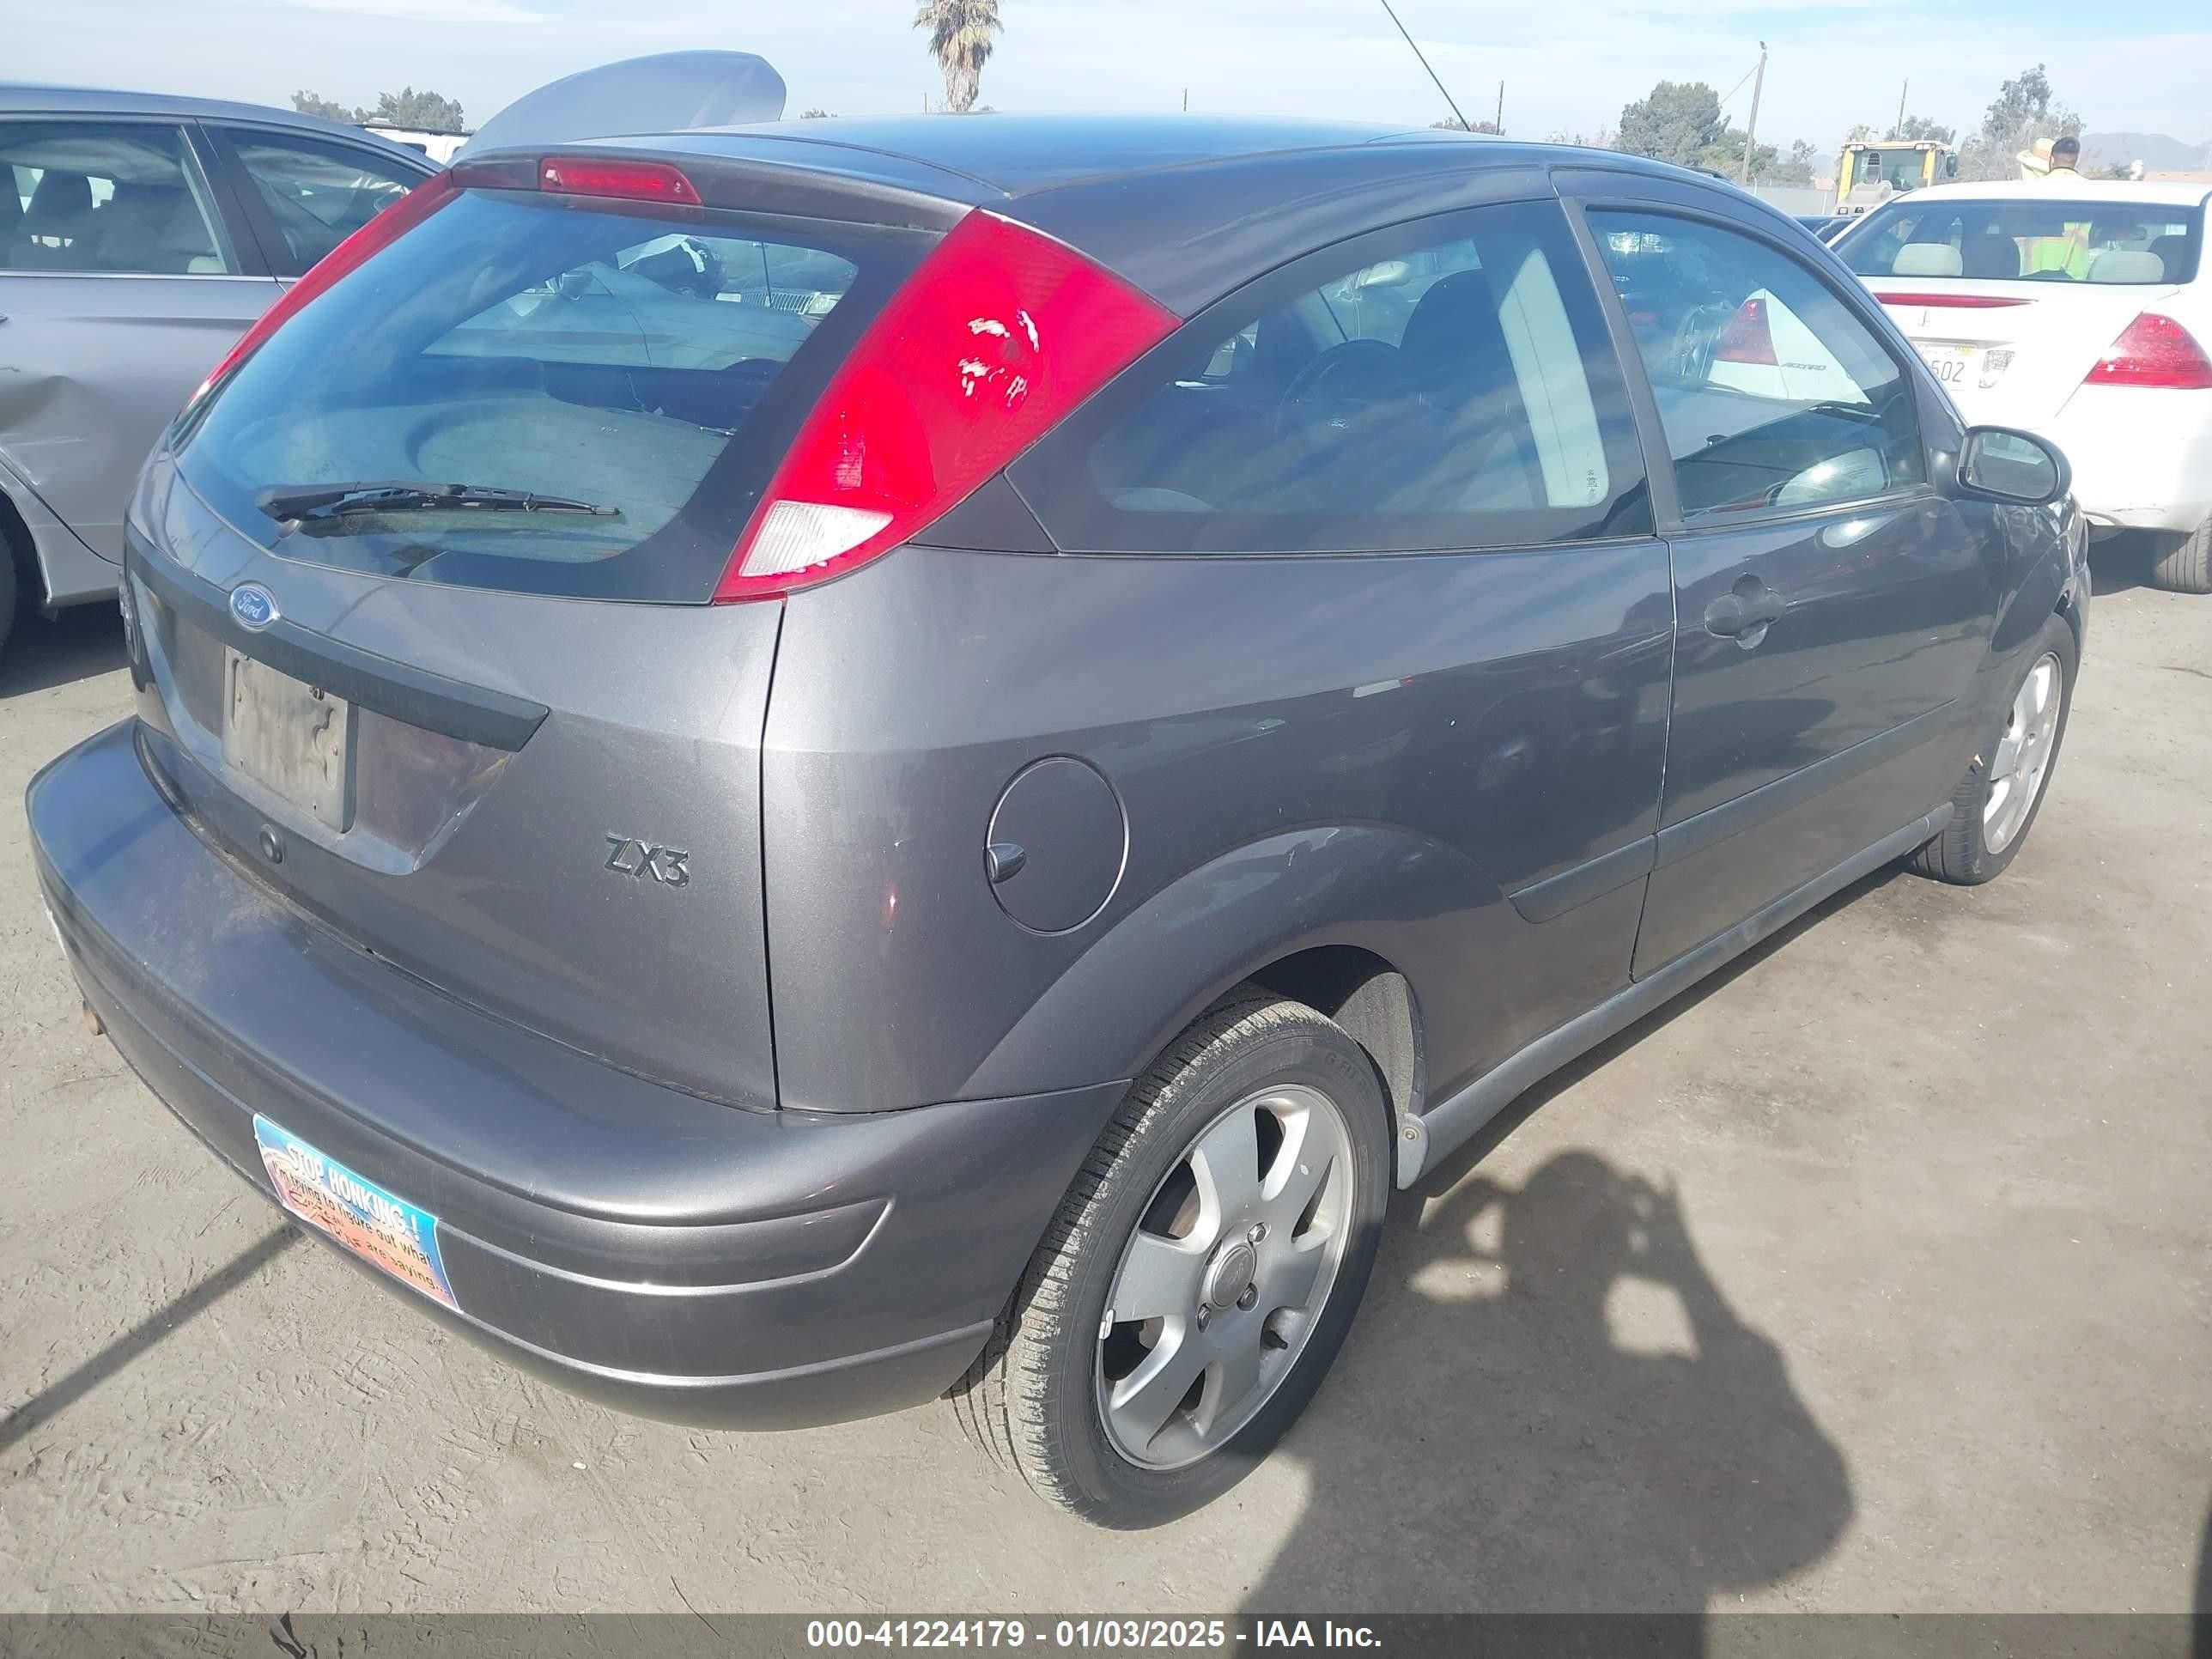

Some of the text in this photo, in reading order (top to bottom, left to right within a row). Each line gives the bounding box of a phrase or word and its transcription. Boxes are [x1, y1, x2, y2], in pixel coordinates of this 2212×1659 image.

[237, 591, 264, 619] Ford
[604, 832, 690, 887] ZX3
[287, 1143, 325, 1184] STOP
[271, 1160, 434, 1268] I'm trying to figure out what
[366, 1241, 386, 1259] are
